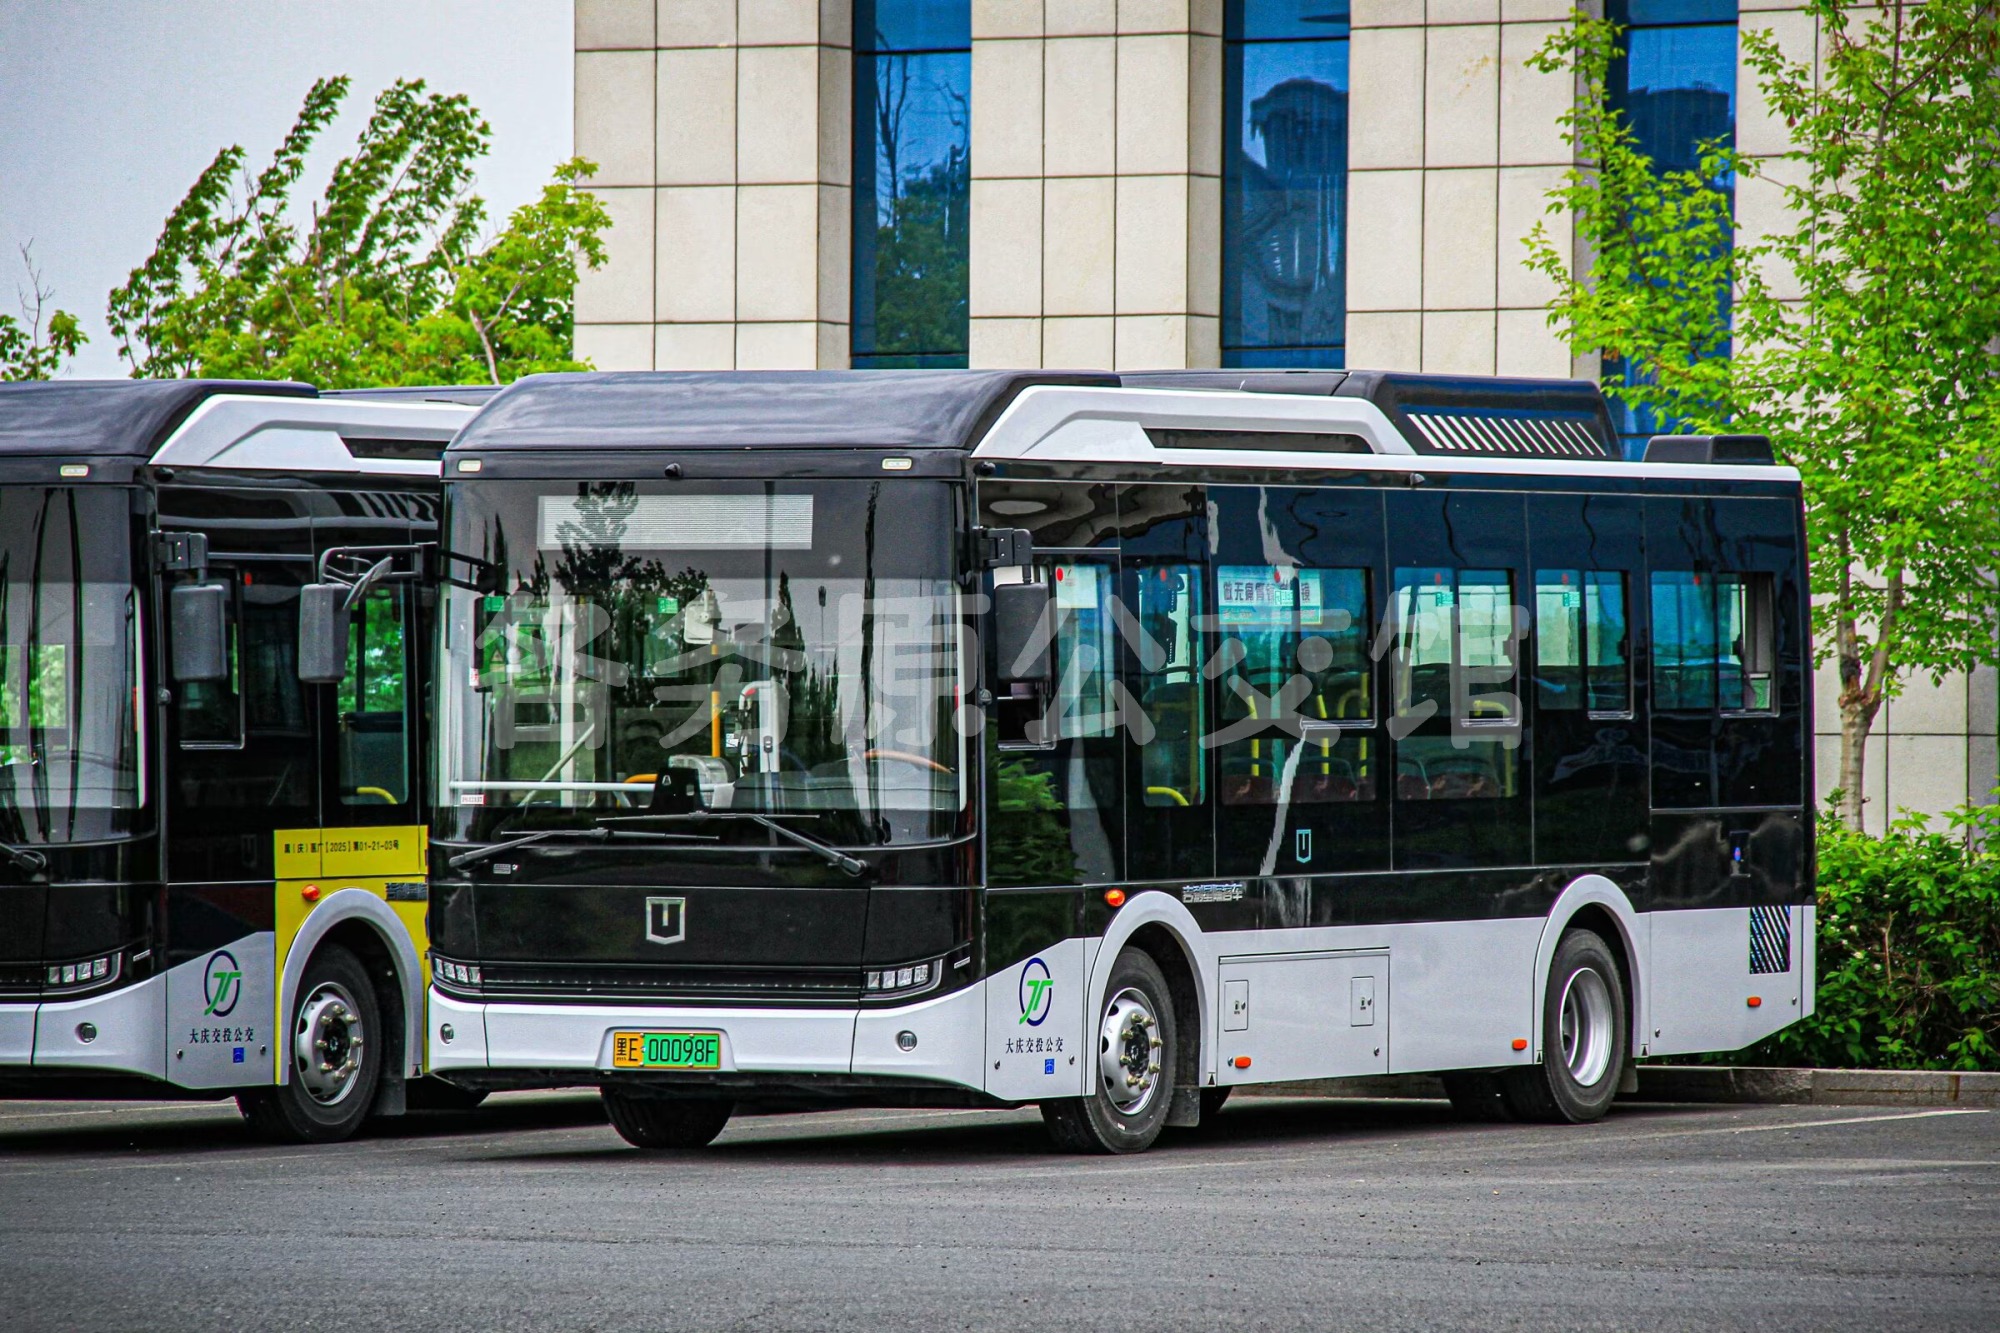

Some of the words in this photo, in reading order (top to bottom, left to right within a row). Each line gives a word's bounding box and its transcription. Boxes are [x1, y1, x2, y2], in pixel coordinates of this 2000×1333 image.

[189, 1026, 254, 1044] 大庆交投公交
[1005, 1036, 1063, 1054] 大庆交投公交
